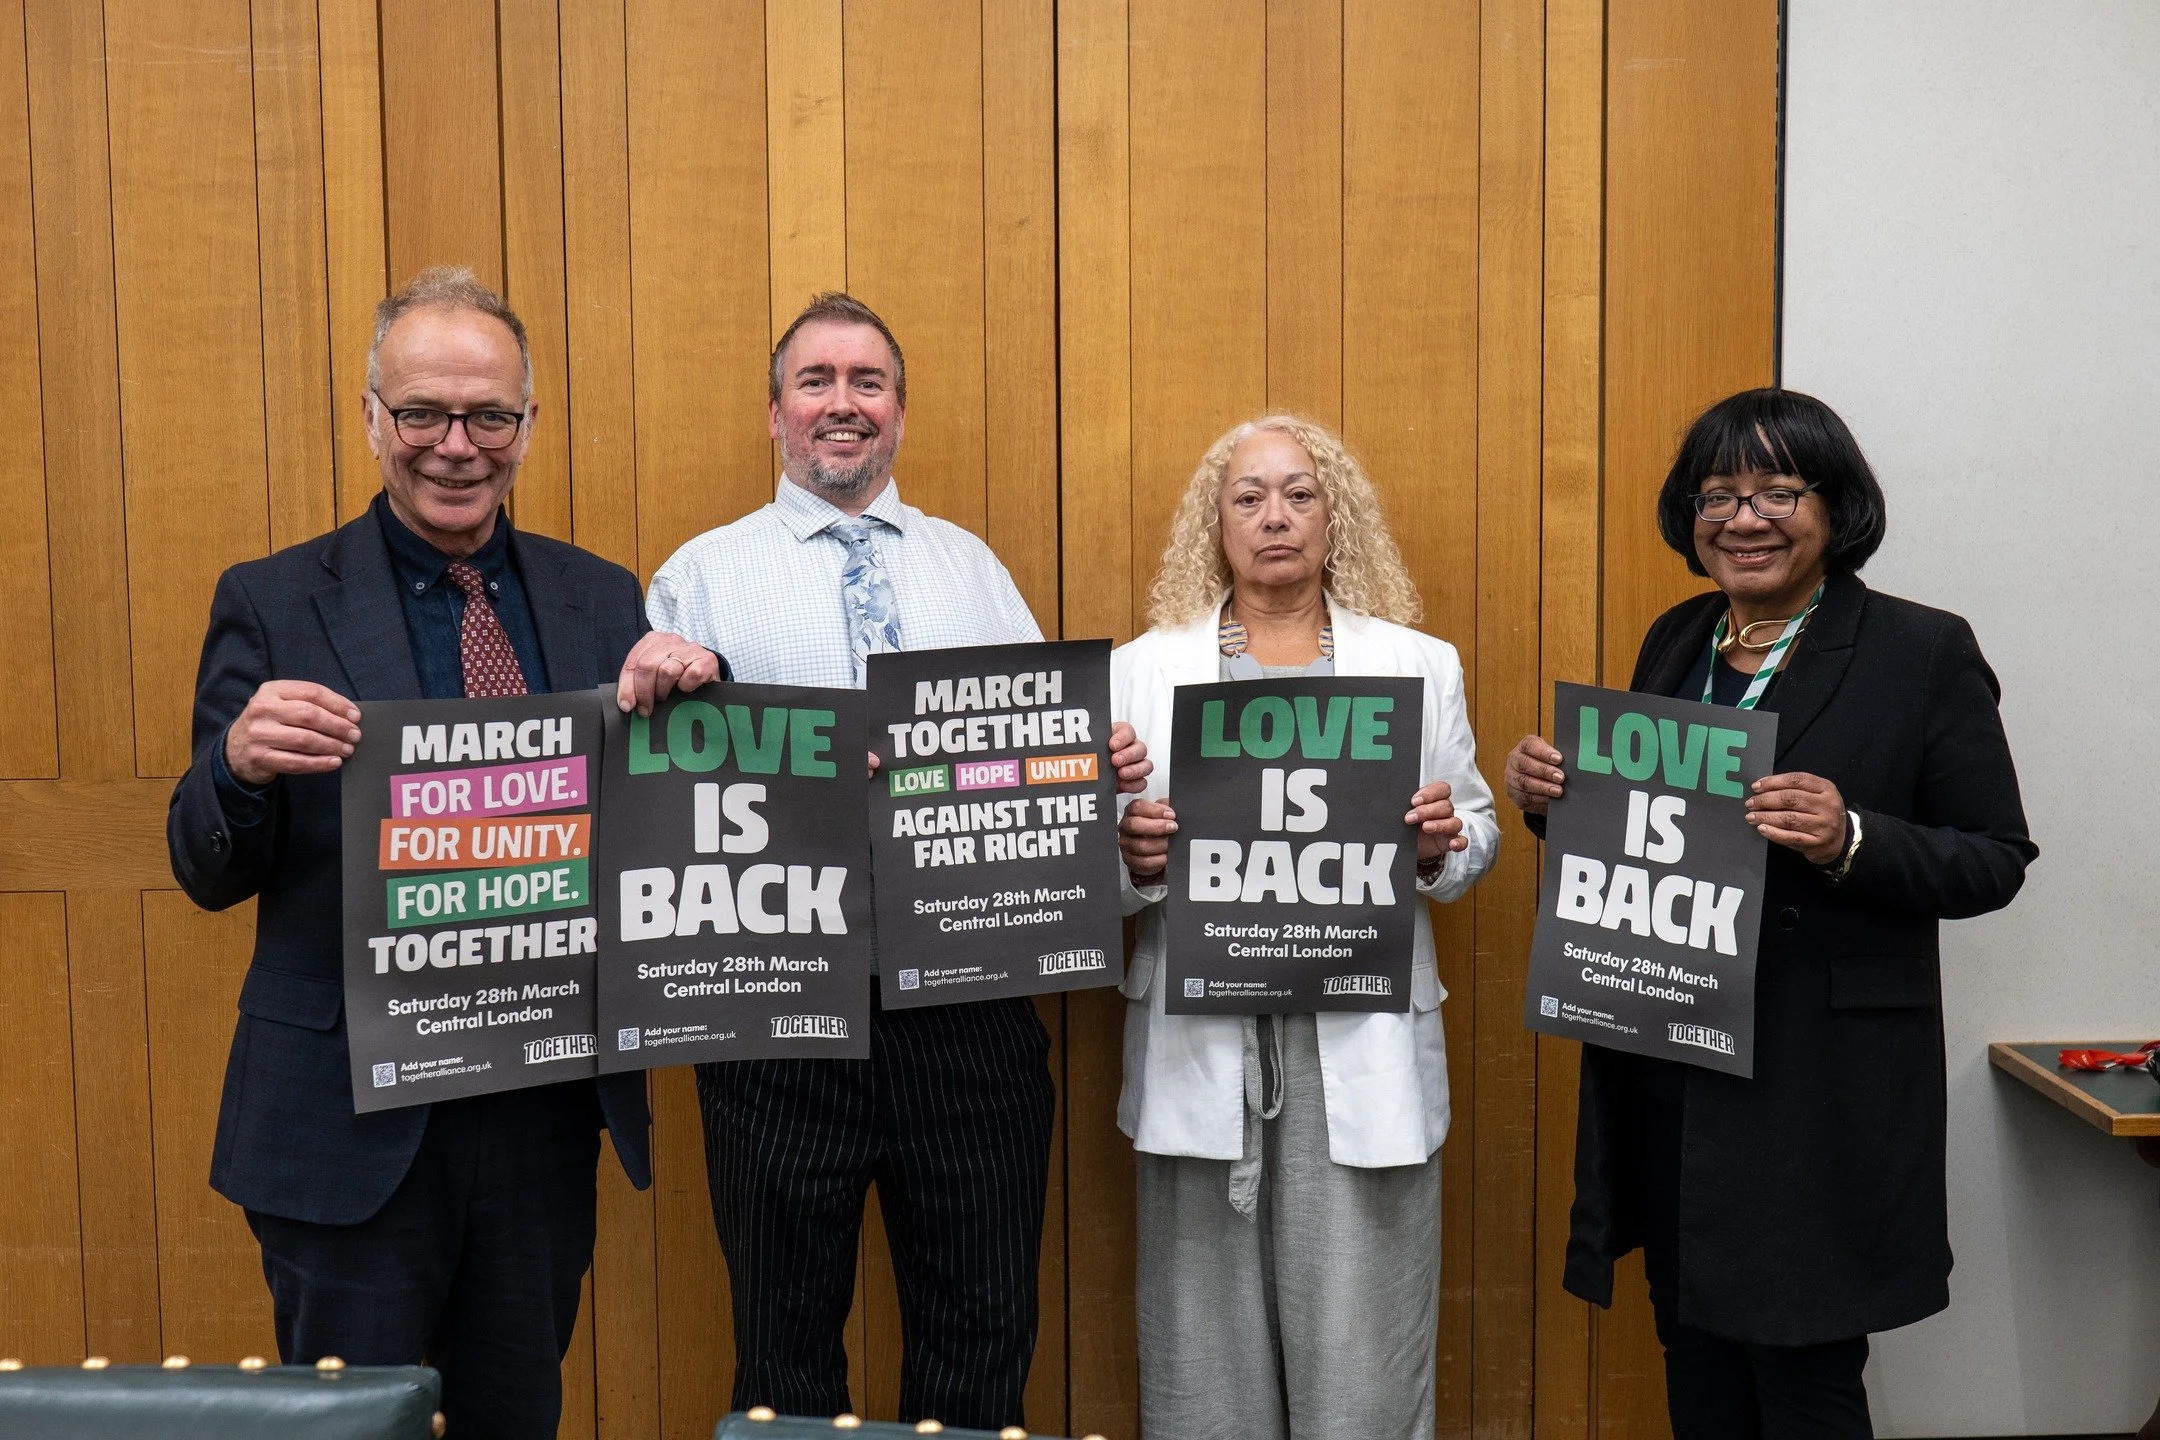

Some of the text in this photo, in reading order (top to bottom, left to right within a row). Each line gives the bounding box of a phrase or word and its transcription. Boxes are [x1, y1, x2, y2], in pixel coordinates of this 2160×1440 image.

[915, 671, 1062, 715] MARCH
[401, 717, 572, 764] MARCH
[629, 701, 836, 777] LOVE
[888, 709, 1091, 758] TOGETHER
[1200, 696, 1394, 760] LOVE
[1577, 706, 1747, 798] LOVE
[401, 767, 578, 816] FOR LOVE.
[894, 758, 1092, 792] LOVE HOPE UNITY
[893, 794, 1097, 837] AGAINST THE
[1261, 768, 1328, 832] IS
[694, 783, 768, 853] IS
[1625, 790, 1686, 864] IS
[390, 823, 581, 861] FOR UNITY.
[914, 827, 1079, 868] FAR RIGHT
[1189, 839, 1397, 906] BACK
[397, 868, 579, 919] FOR HOPE.
[620, 864, 847, 942] BACK
[914, 885, 1086, 915] Saturday 28th March
[1556, 854, 1744, 956] BACK
[940, 909, 1062, 933] Central London
[1204, 923, 1378, 941] Saturday 28th March
[368, 918, 598, 974] TOGETHER
[1038, 949, 1105, 975] TOGETHER
[1228, 943, 1352, 958] Central London
[638, 956, 828, 980] Saturday 28th March
[924, 965, 982, 977] Add your name:
[924, 970, 1008, 986] togetheralliance.org.uk
[1563, 942, 1718, 990] Saturday 28th March
[388, 981, 580, 1016] Saturday 28th March
[663, 978, 801, 998] Central London
[1209, 980, 1223, 988] Add
[1225, 982, 1243, 990] your
[1209, 989, 1292, 998] togetheralliance.org.uk
[1323, 975, 1391, 995] TOGETHER
[1582, 968, 1694, 1005] Central London
[416, 1007, 553, 1035] Central London
[771, 1015, 849, 1037] TOGETHER
[1562, 1002, 1614, 1020] Add your name:
[1562, 1011, 1638, 1035] togetheralliance.org.uk
[644, 1023, 707, 1036] Add your name:
[644, 1031, 736, 1047] togetheralliance.org.uk
[1668, 1023, 1735, 1055] TOGETHER
[401, 1056, 463, 1071] Add your name:
[524, 1035, 598, 1063] TOGETHER
[401, 1062, 492, 1082] togetheralliance.org.uk
